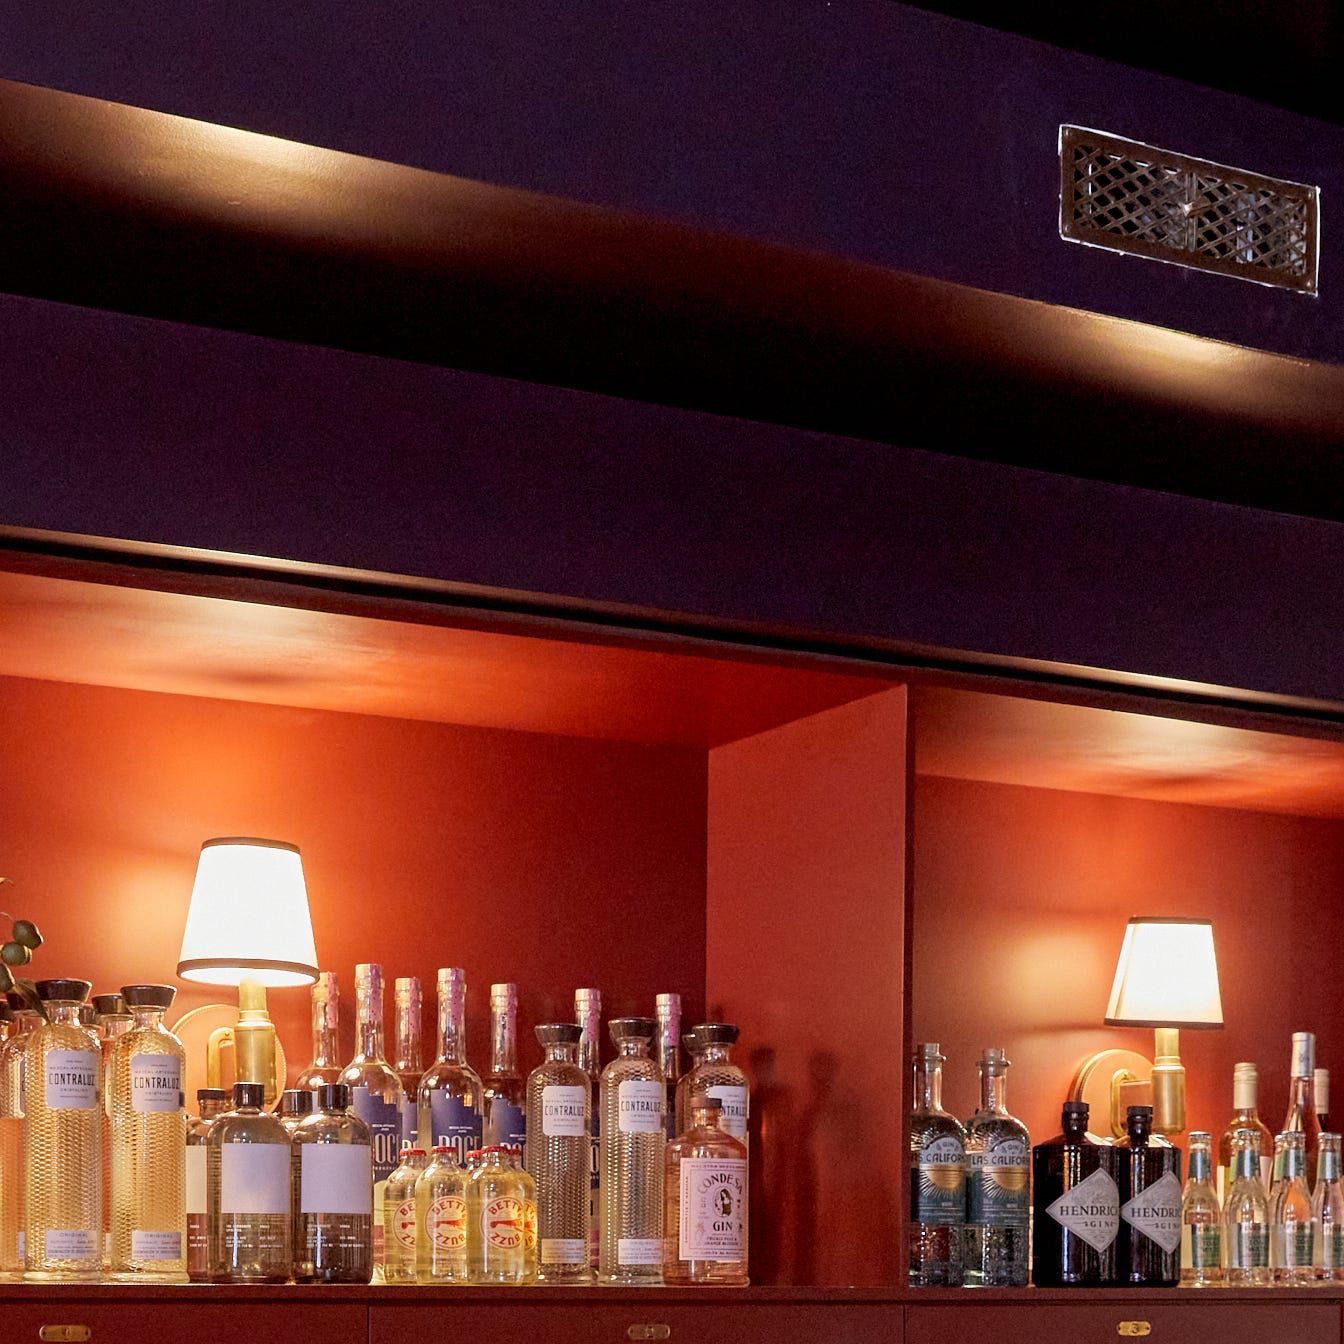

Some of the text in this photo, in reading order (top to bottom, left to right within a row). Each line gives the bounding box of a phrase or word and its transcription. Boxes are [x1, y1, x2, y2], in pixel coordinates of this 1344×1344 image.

[48, 1072, 96, 1086] CONTRALUZ
[134, 1076, 180, 1090] CONTRALUZ
[544, 1105, 584, 1117] CONTRALUZ
[620, 1100, 661, 1113] CONTRALUZ
[972, 1155, 989, 1165] LAS
[697, 1172, 743, 1195] CONDESA
[488, 1199, 522, 1216] BETTY
[712, 1220, 734, 1232] GIN
